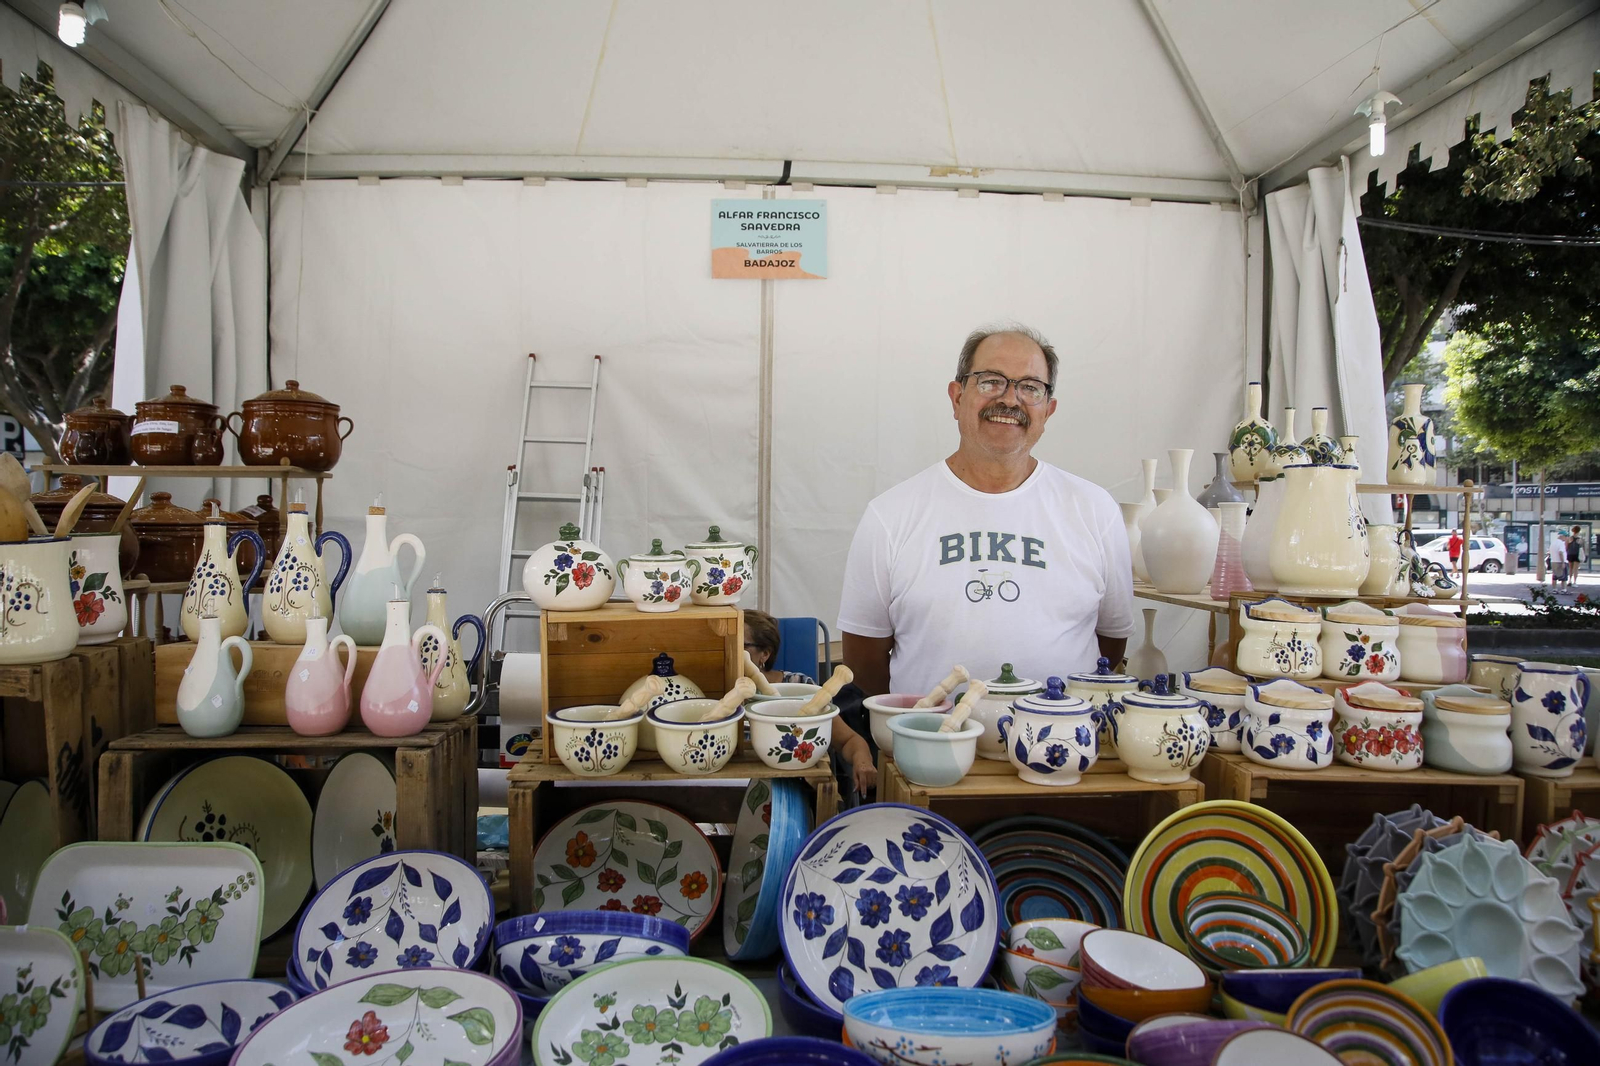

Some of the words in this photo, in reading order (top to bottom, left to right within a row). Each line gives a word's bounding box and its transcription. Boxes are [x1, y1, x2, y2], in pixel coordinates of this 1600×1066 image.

[718, 211, 754, 220] ALFAR
[756, 211, 820, 220] FRANCISCO
[740, 222, 801, 231] SAAVEDRA
[744, 260, 795, 268] BADAJOZ
[939, 531, 1046, 569] BIKE
